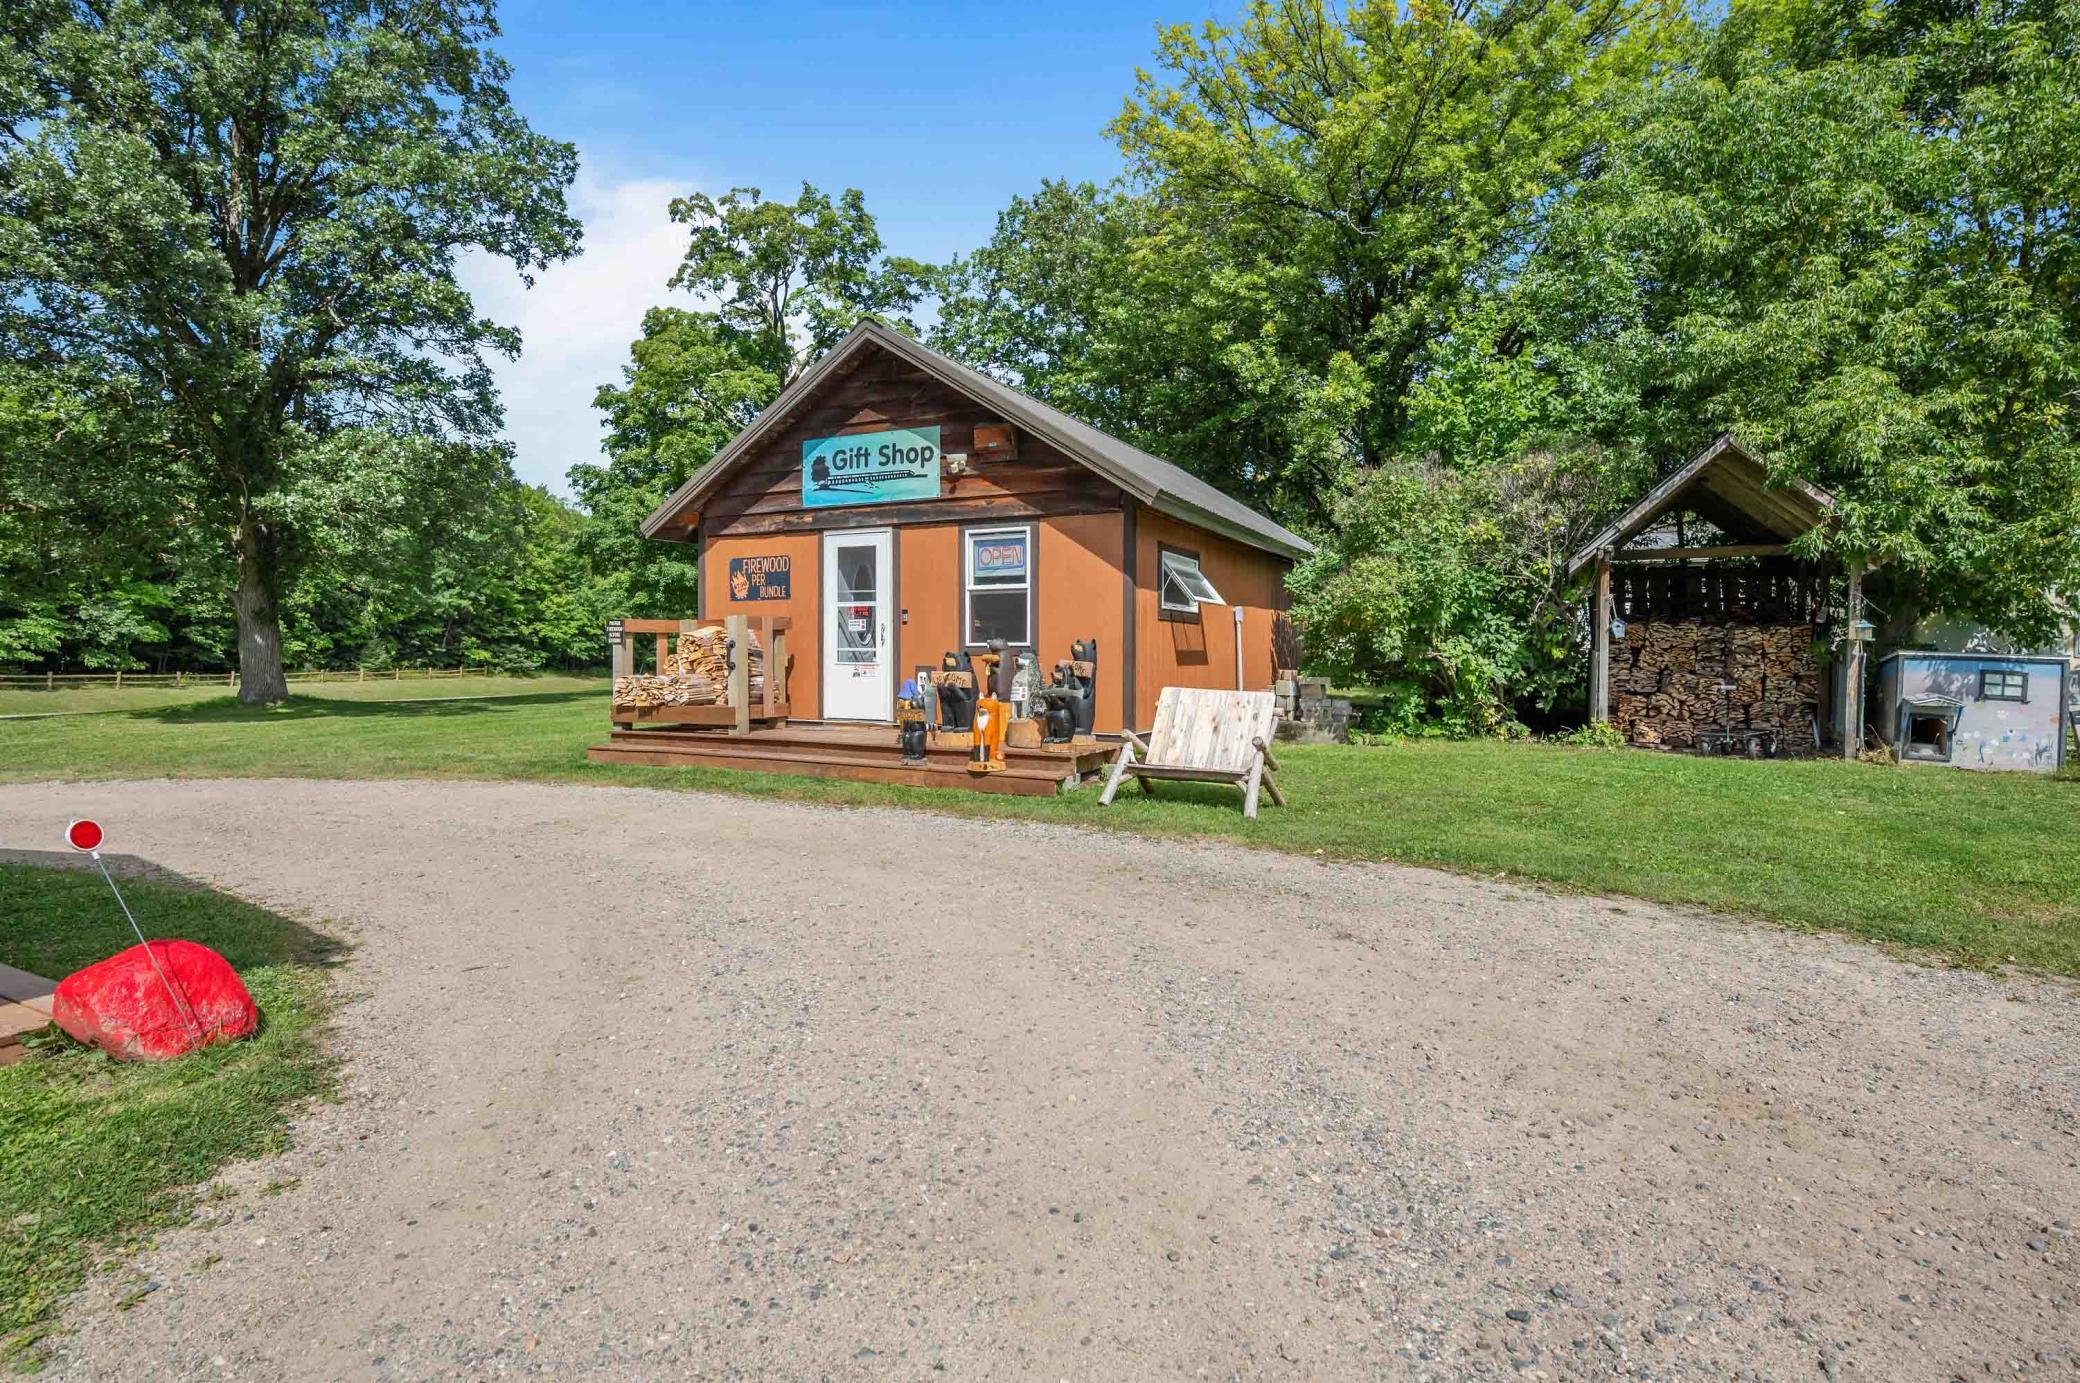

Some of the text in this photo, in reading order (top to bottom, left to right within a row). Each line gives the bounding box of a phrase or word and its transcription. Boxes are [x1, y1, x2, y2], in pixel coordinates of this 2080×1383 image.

[832, 442, 934, 470] Gift Shop
[743, 556, 789, 574] FIREWOOD
[980, 547, 1022, 566] OPEN
[752, 573, 766, 587] PER
[759, 585, 786, 598] BUNDLE
